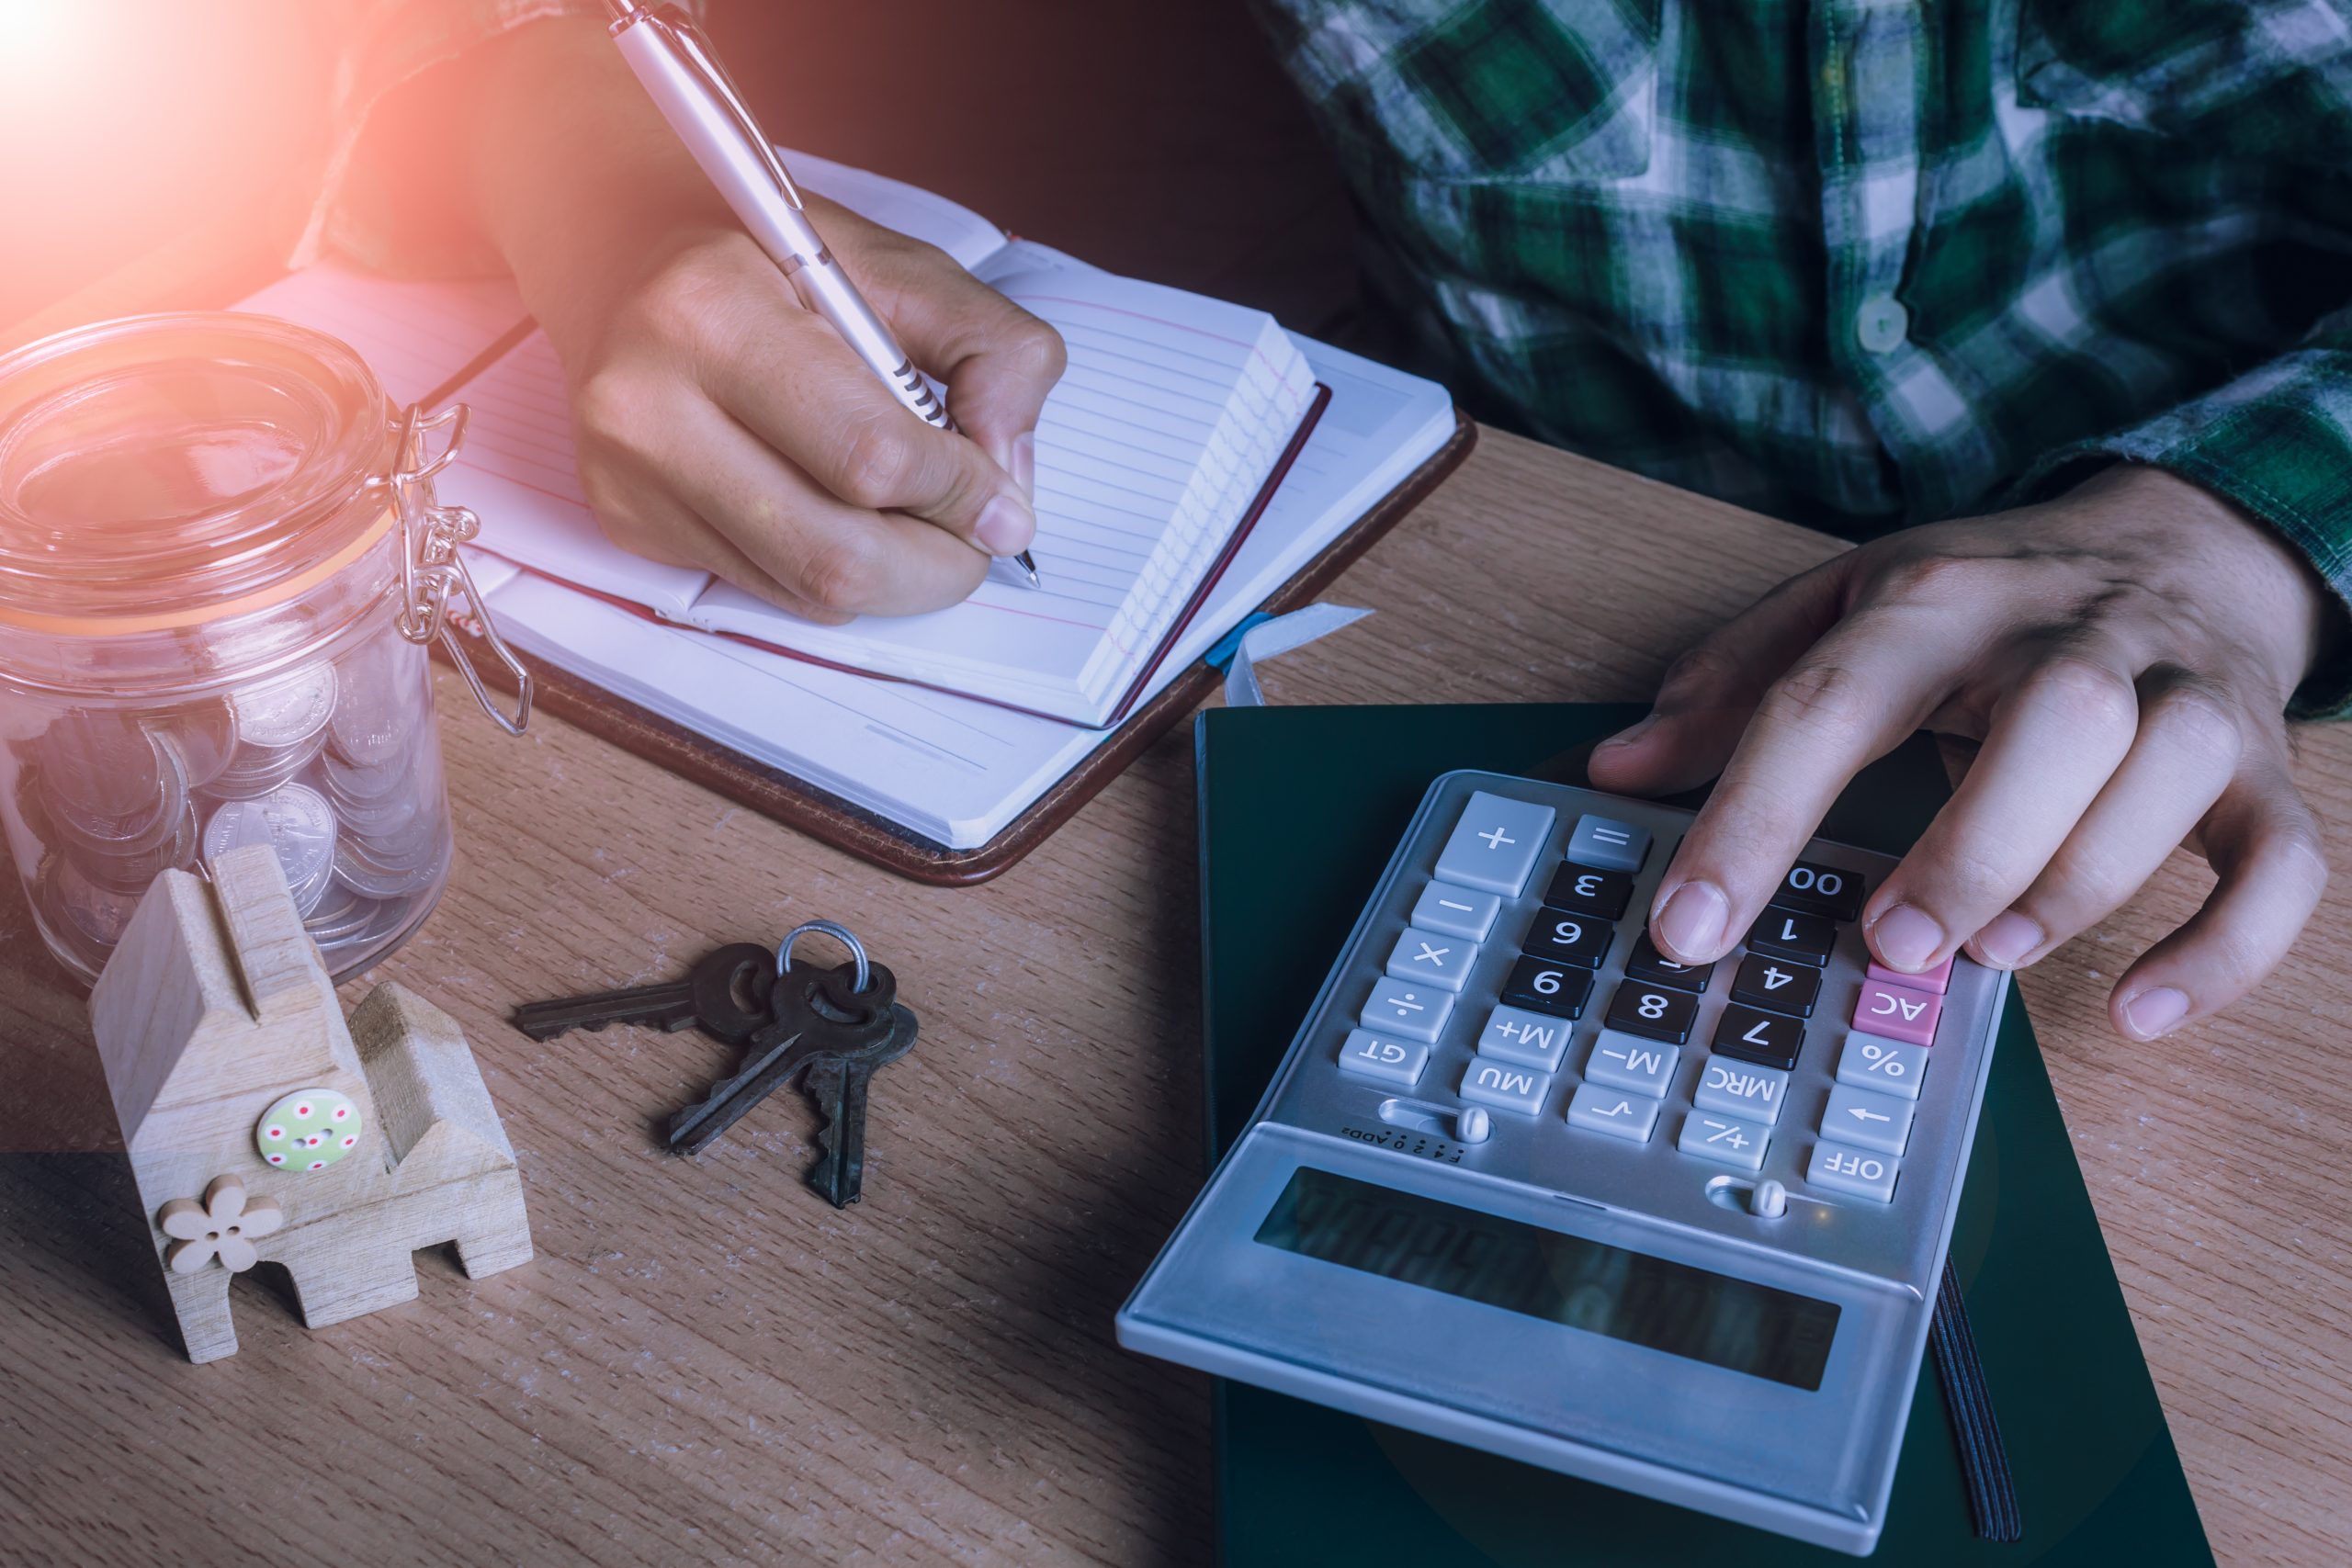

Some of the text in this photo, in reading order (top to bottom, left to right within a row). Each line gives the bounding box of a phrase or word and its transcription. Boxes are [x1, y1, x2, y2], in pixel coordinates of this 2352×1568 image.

[1574, 874, 1603, 897] 3
[1789, 866, 1843, 896] 00
[1552, 921, 1582, 944] 6
[1781, 919, 1798, 941] 1
[1533, 970, 1564, 995] 9
[1763, 966, 1793, 990] 4
[1637, 994, 1668, 1019] 8
[1871, 992, 1928, 1021] AC
[1495, 1021, 1555, 1050] M+
[1742, 1021, 1770, 1045] 7
[1358, 1039, 1407, 1064] GT
[1861, 1044, 1905, 1077] %
[1476, 1066, 1533, 1096] MU
[1706, 1066, 1776, 1102] MRC
[1413, 1145, 1425, 1155] 2
[1434, 1149, 1444, 1158] 4
[1449, 1156, 1461, 1164] F
[1824, 1152, 1884, 1181] OFF
